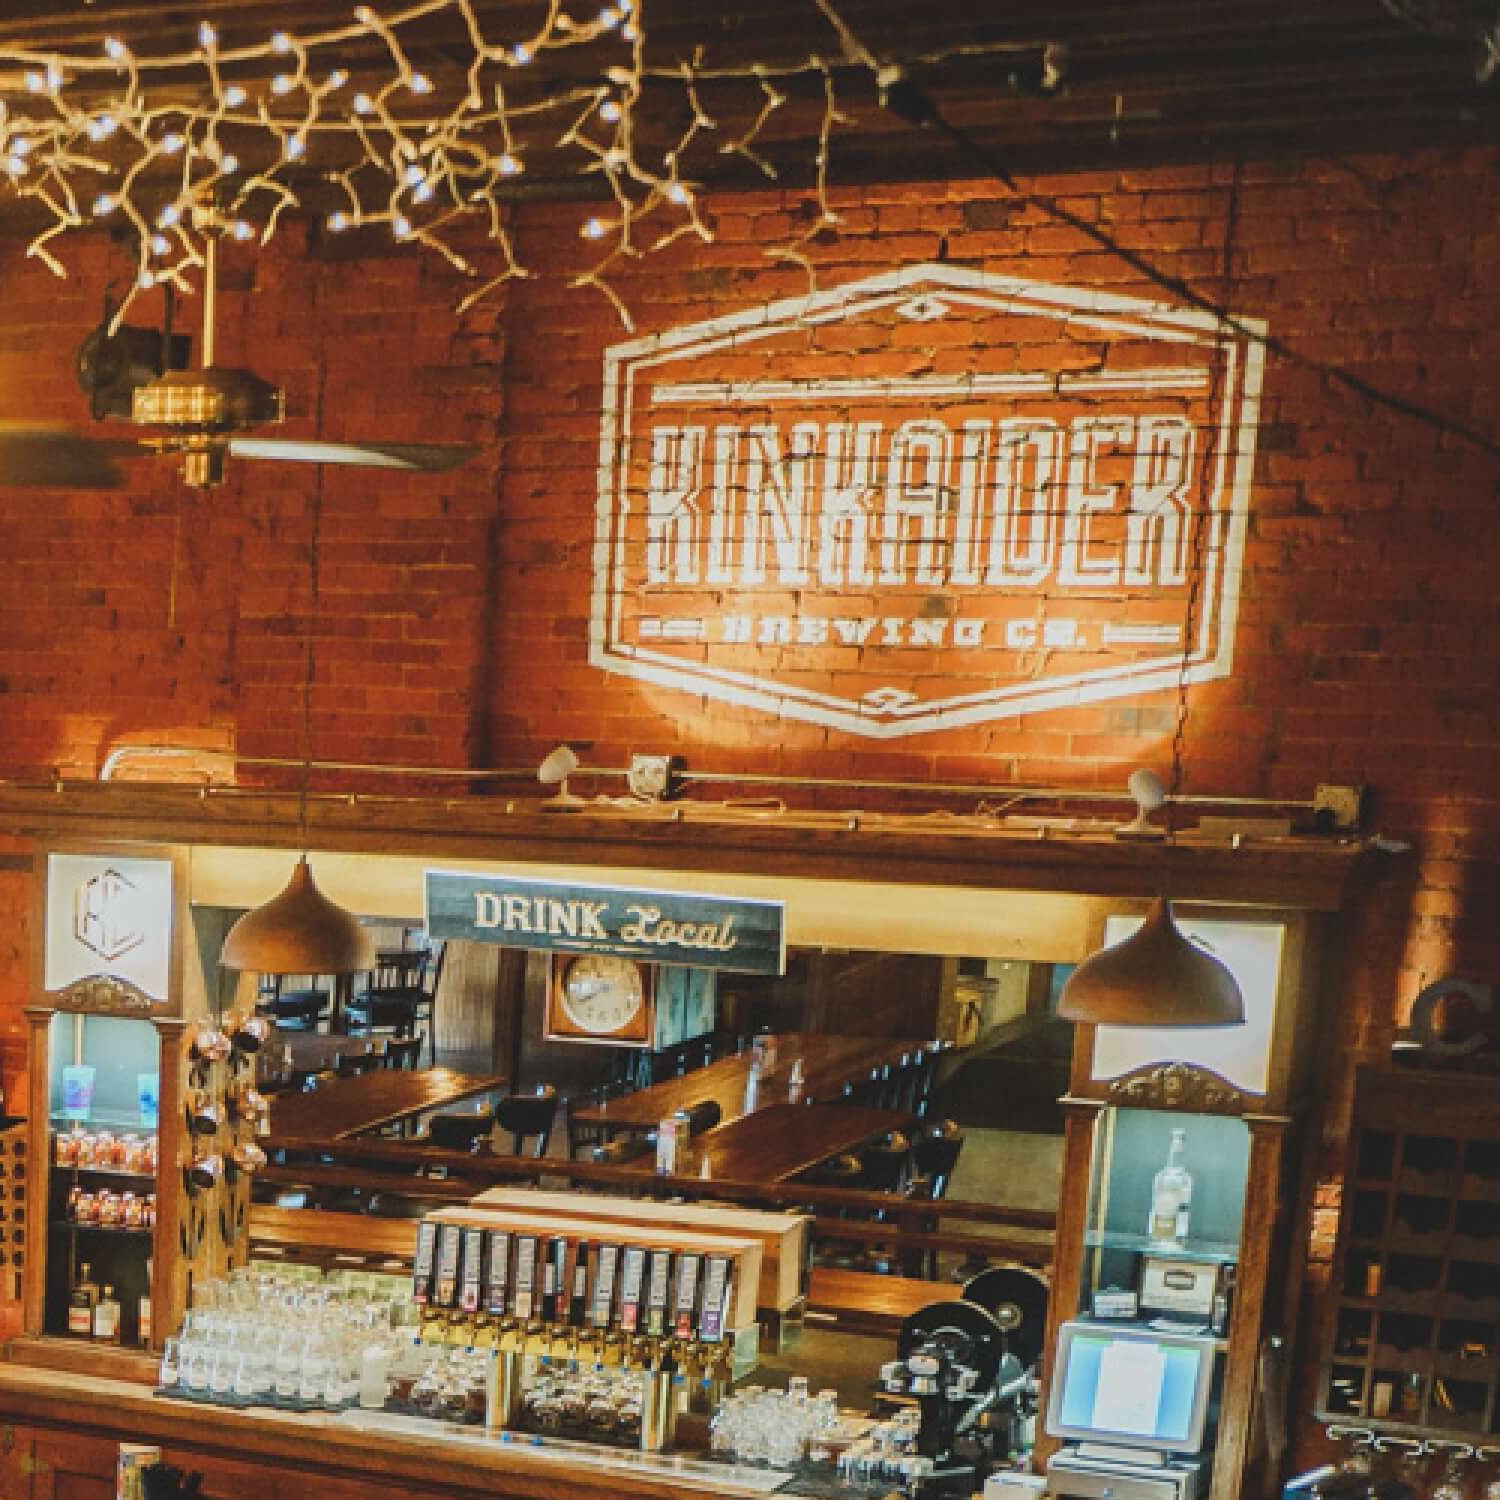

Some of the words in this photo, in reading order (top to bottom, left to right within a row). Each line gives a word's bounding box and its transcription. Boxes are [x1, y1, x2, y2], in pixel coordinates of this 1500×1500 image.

[646, 415, 1195, 587] KINKAIDER
[721, 616, 983, 648] BREWING
[474, 890, 609, 940] DRINK
[620, 904, 738, 952] Local
